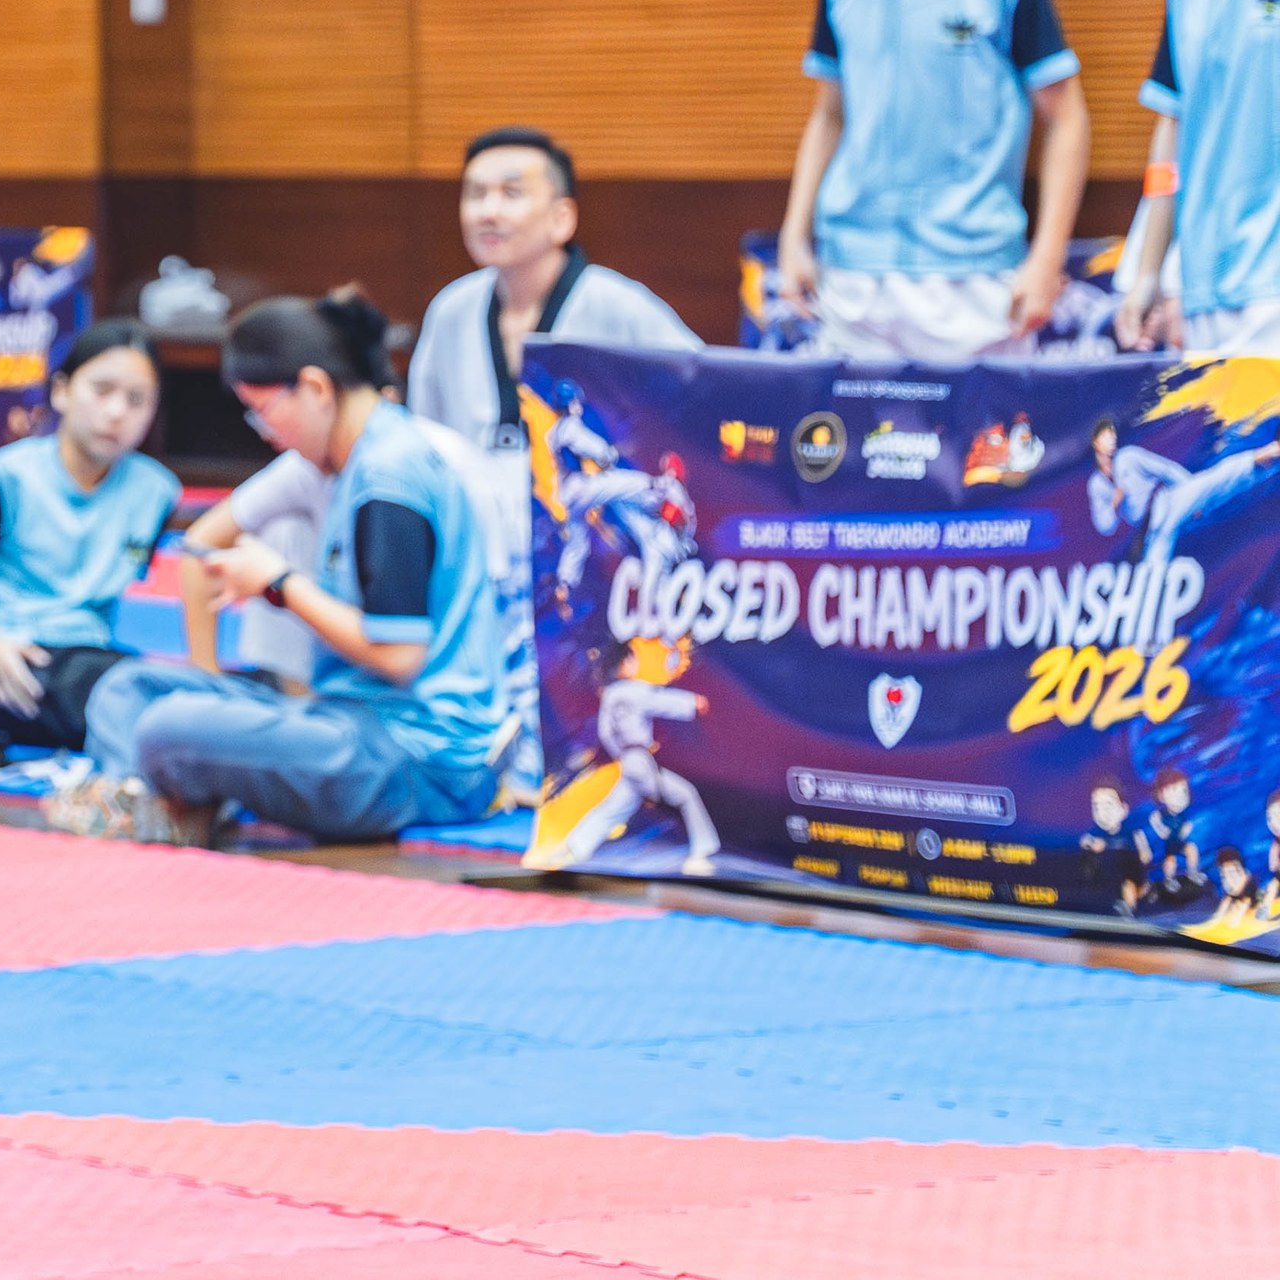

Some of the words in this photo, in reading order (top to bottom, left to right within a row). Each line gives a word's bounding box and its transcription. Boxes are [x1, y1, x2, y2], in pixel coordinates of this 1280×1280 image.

[942, 519, 1031, 549] ACADEMY
[607, 555, 801, 645] CLOSED
[808, 556, 1205, 655] CHAMPIONSHIP
[1008, 635, 1190, 734] 2026
